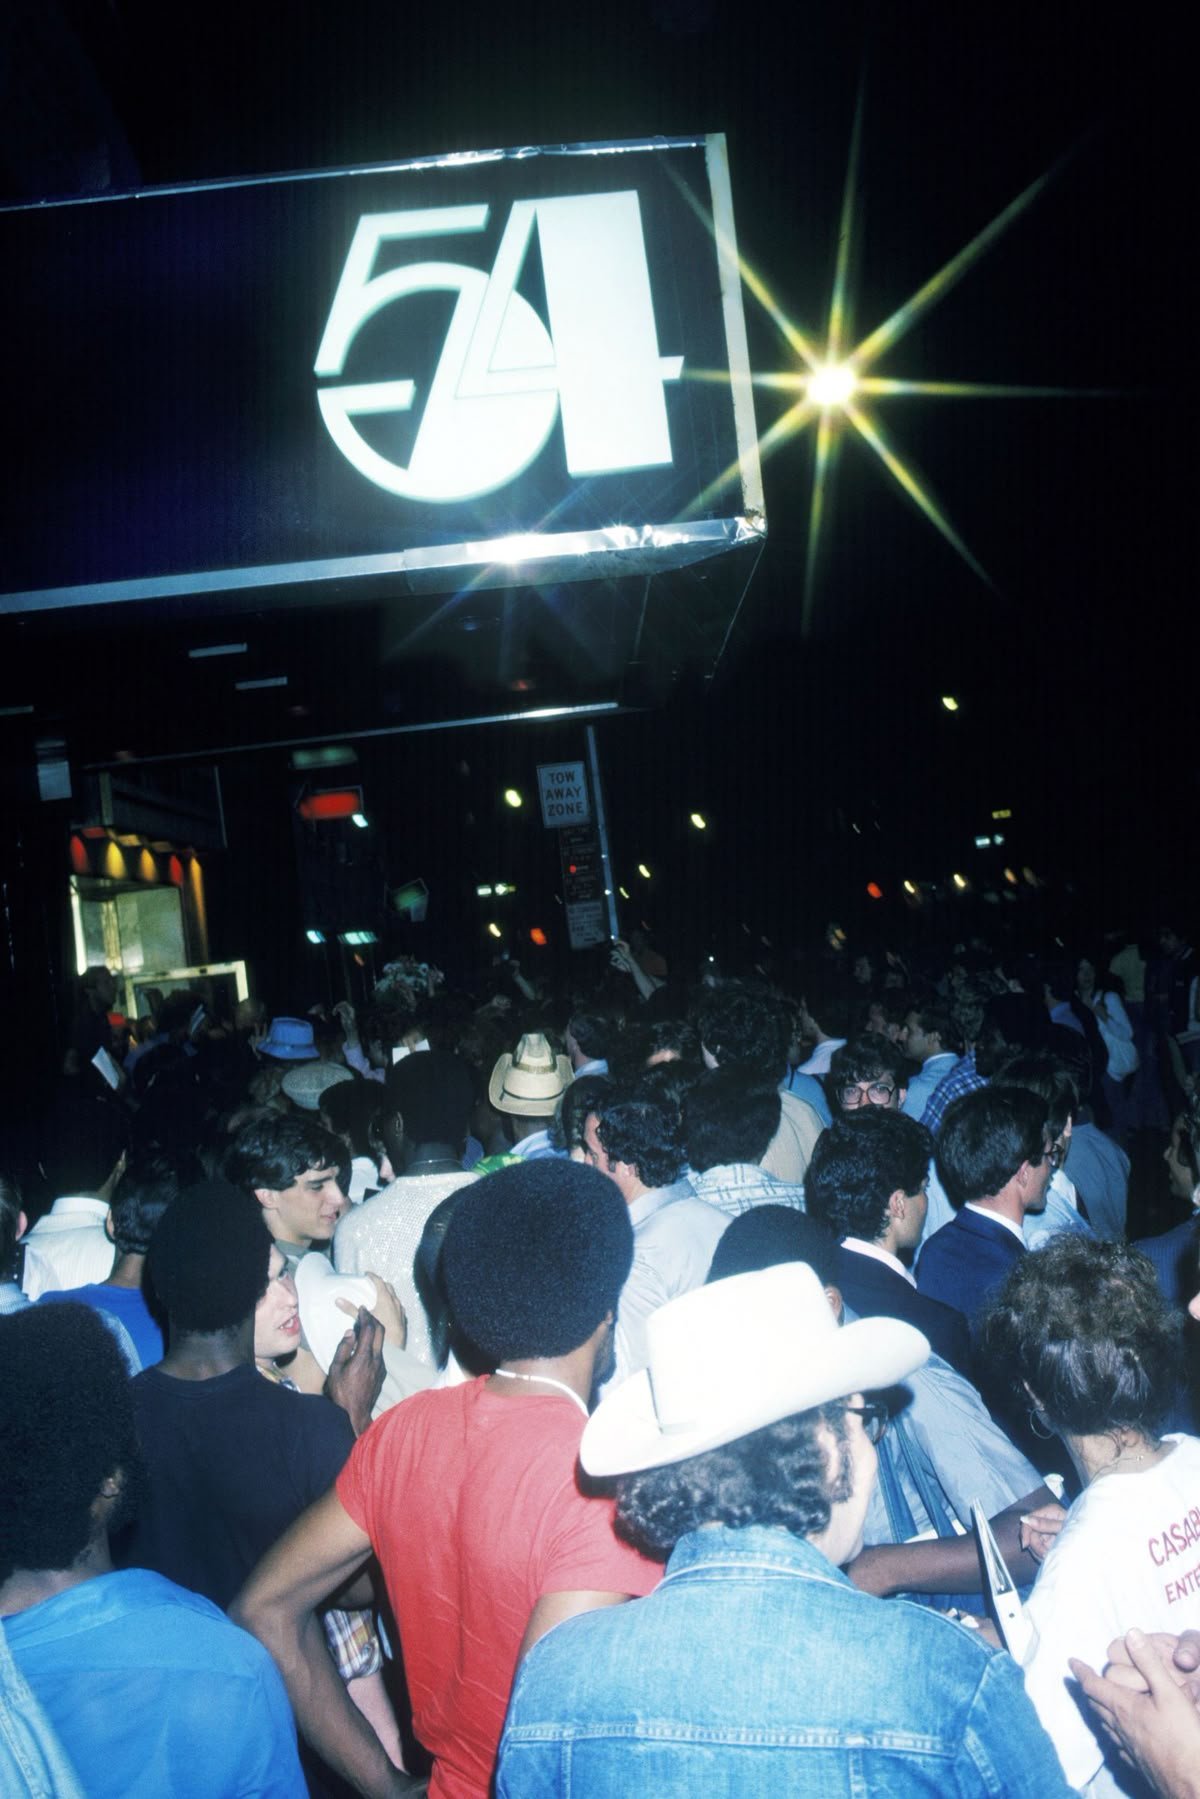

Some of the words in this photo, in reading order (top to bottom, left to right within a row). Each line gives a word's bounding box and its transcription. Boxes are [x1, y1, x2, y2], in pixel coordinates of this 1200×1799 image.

[313, 190, 685, 504] 54
[548, 770, 576, 784] TOW
[545, 786, 581, 801] AWAY
[547, 801, 584, 817] ZONE
[1148, 1506, 1200, 1567] CASAB
[1164, 1563, 1200, 1605] ENTE
